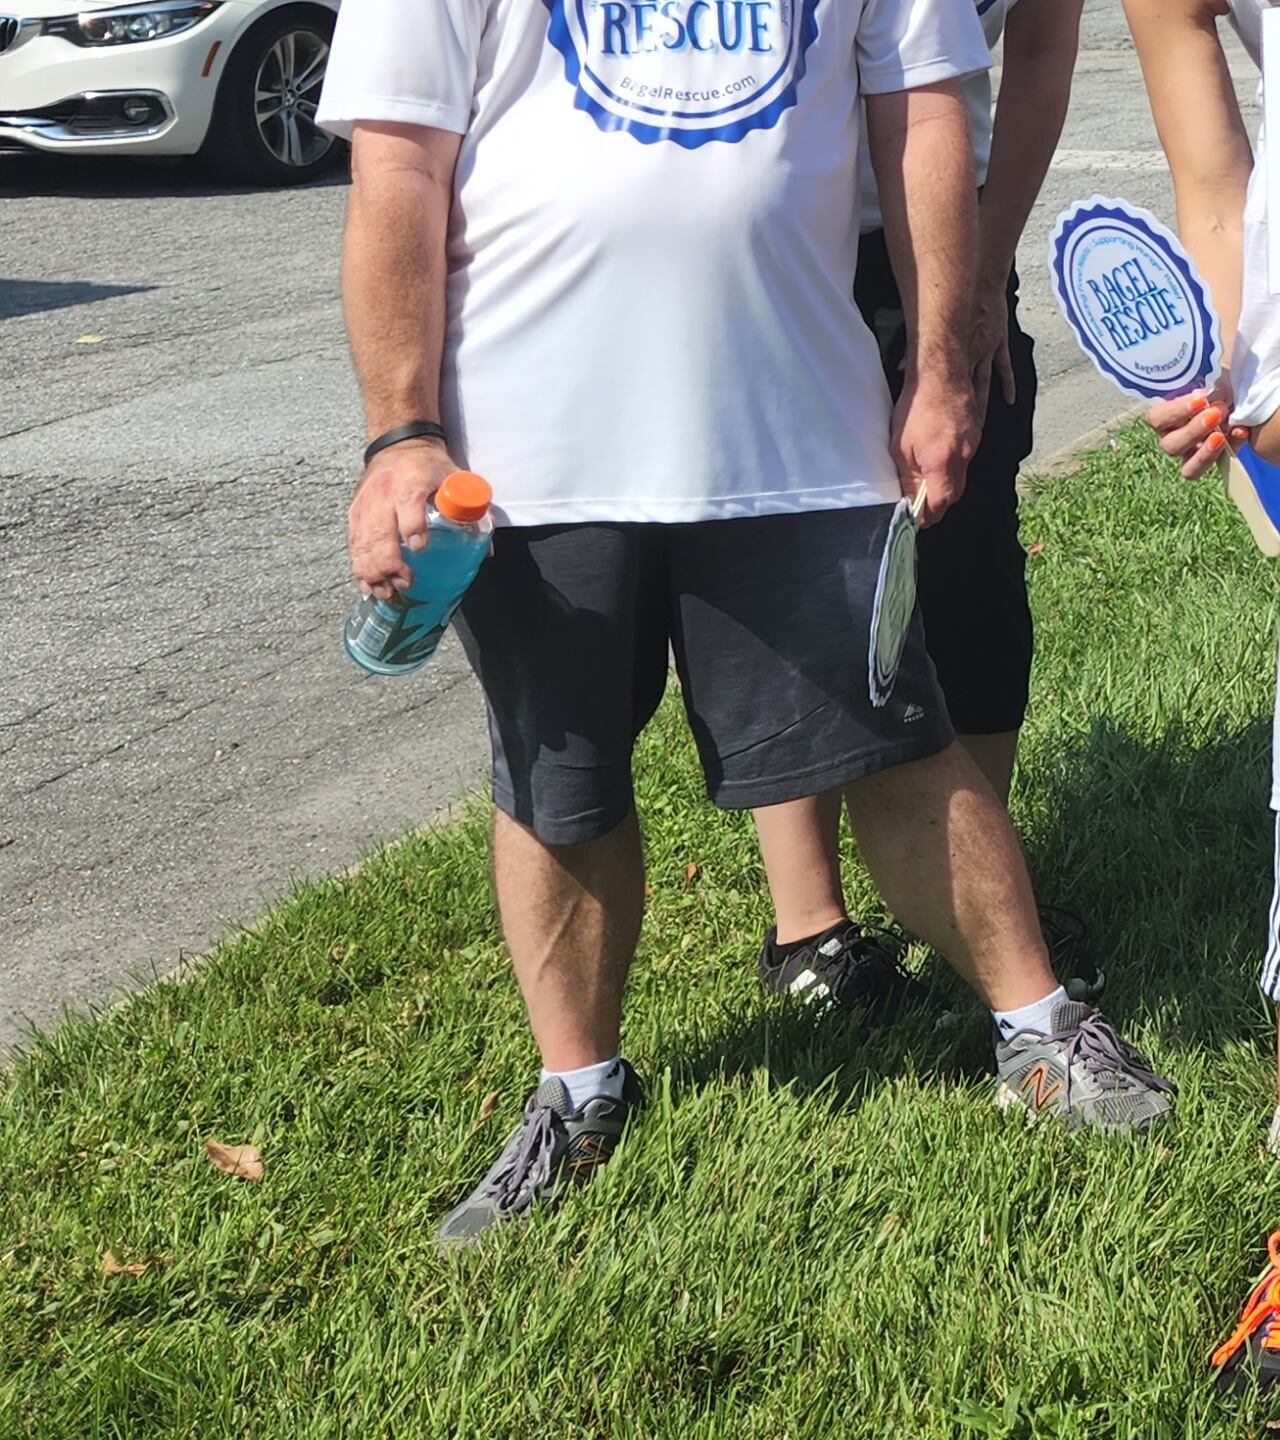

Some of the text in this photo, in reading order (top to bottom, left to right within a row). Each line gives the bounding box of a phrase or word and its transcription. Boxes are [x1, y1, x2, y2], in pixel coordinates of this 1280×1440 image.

[601, 2, 773, 55] RESCUE
[619, 74, 756, 102] BagelRescue.com
[1086, 257, 1157, 313] BAGEL
[1100, 288, 1184, 350] RESCUE
